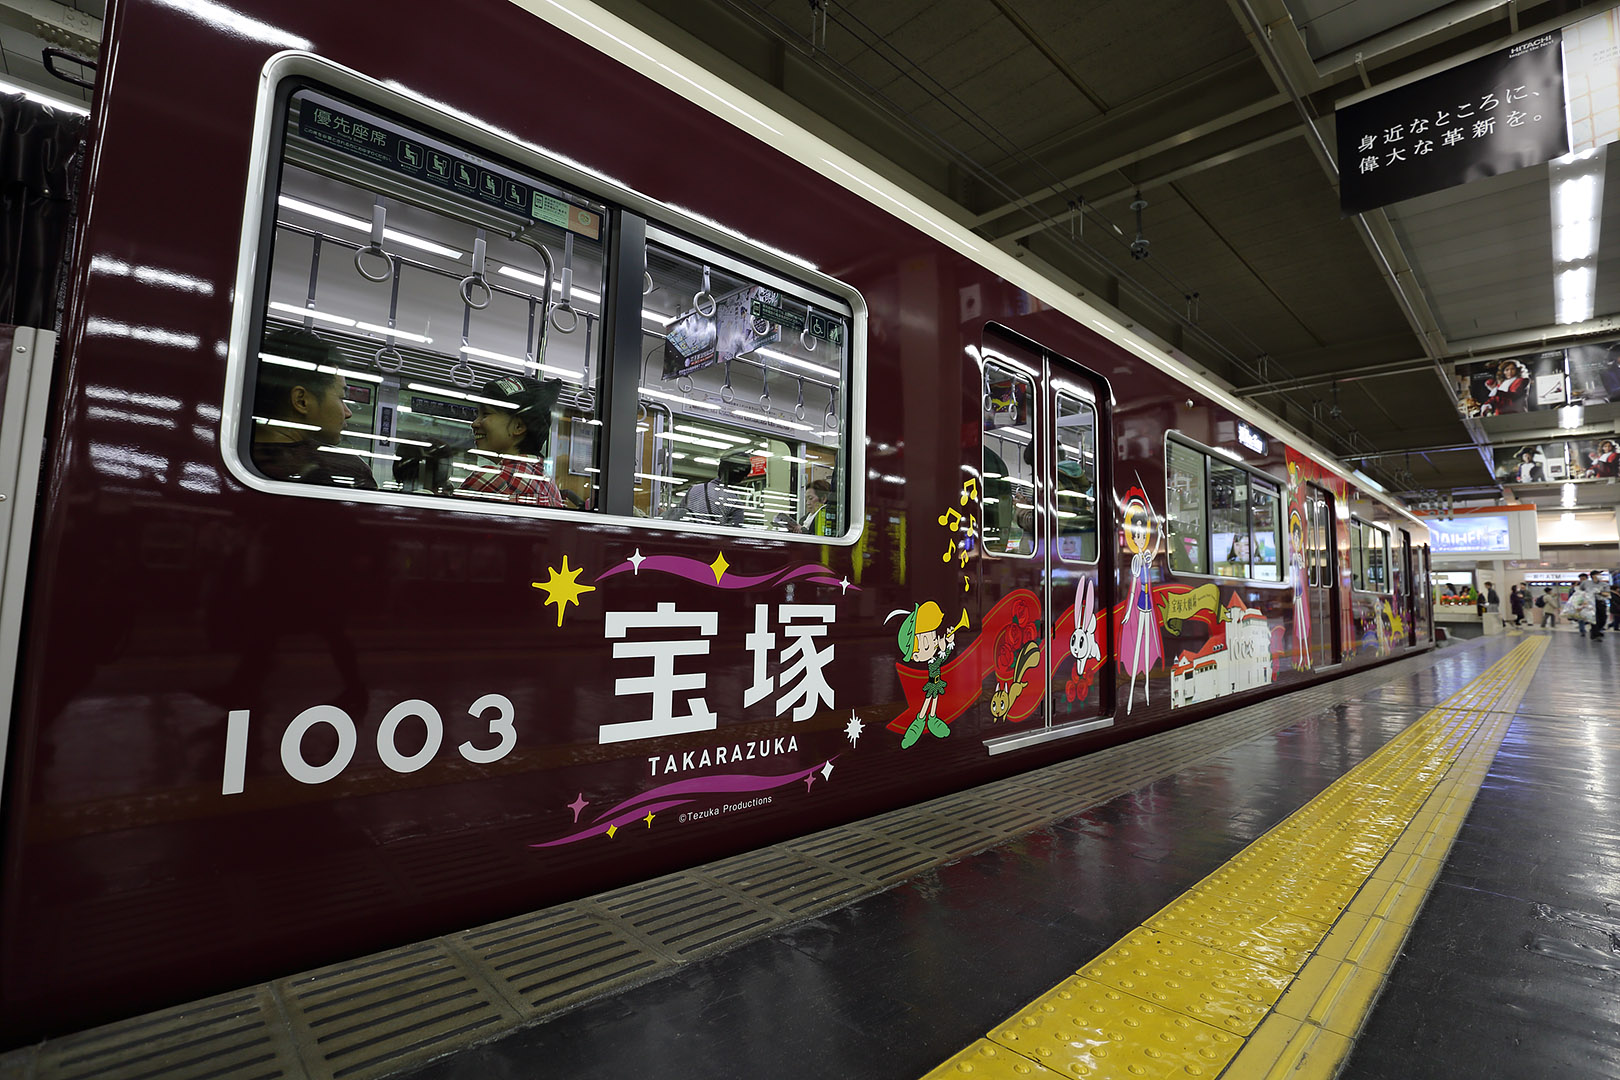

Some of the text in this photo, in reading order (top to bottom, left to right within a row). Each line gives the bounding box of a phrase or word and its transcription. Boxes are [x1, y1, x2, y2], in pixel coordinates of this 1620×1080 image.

[1510, 35, 1552, 54] HITACHI
[313, 107, 388, 148] 優先座席
[1358, 85, 1541, 152] 身近なところに、
[1358, 109, 1543, 174] 偉大な革新を。
[599, 602, 836, 745] 宝塚
[222, 693, 518, 796] 1003
[648, 734, 800, 777] TAKARAZUKA
[678, 796, 773, 824] ©Tezuka Productions
